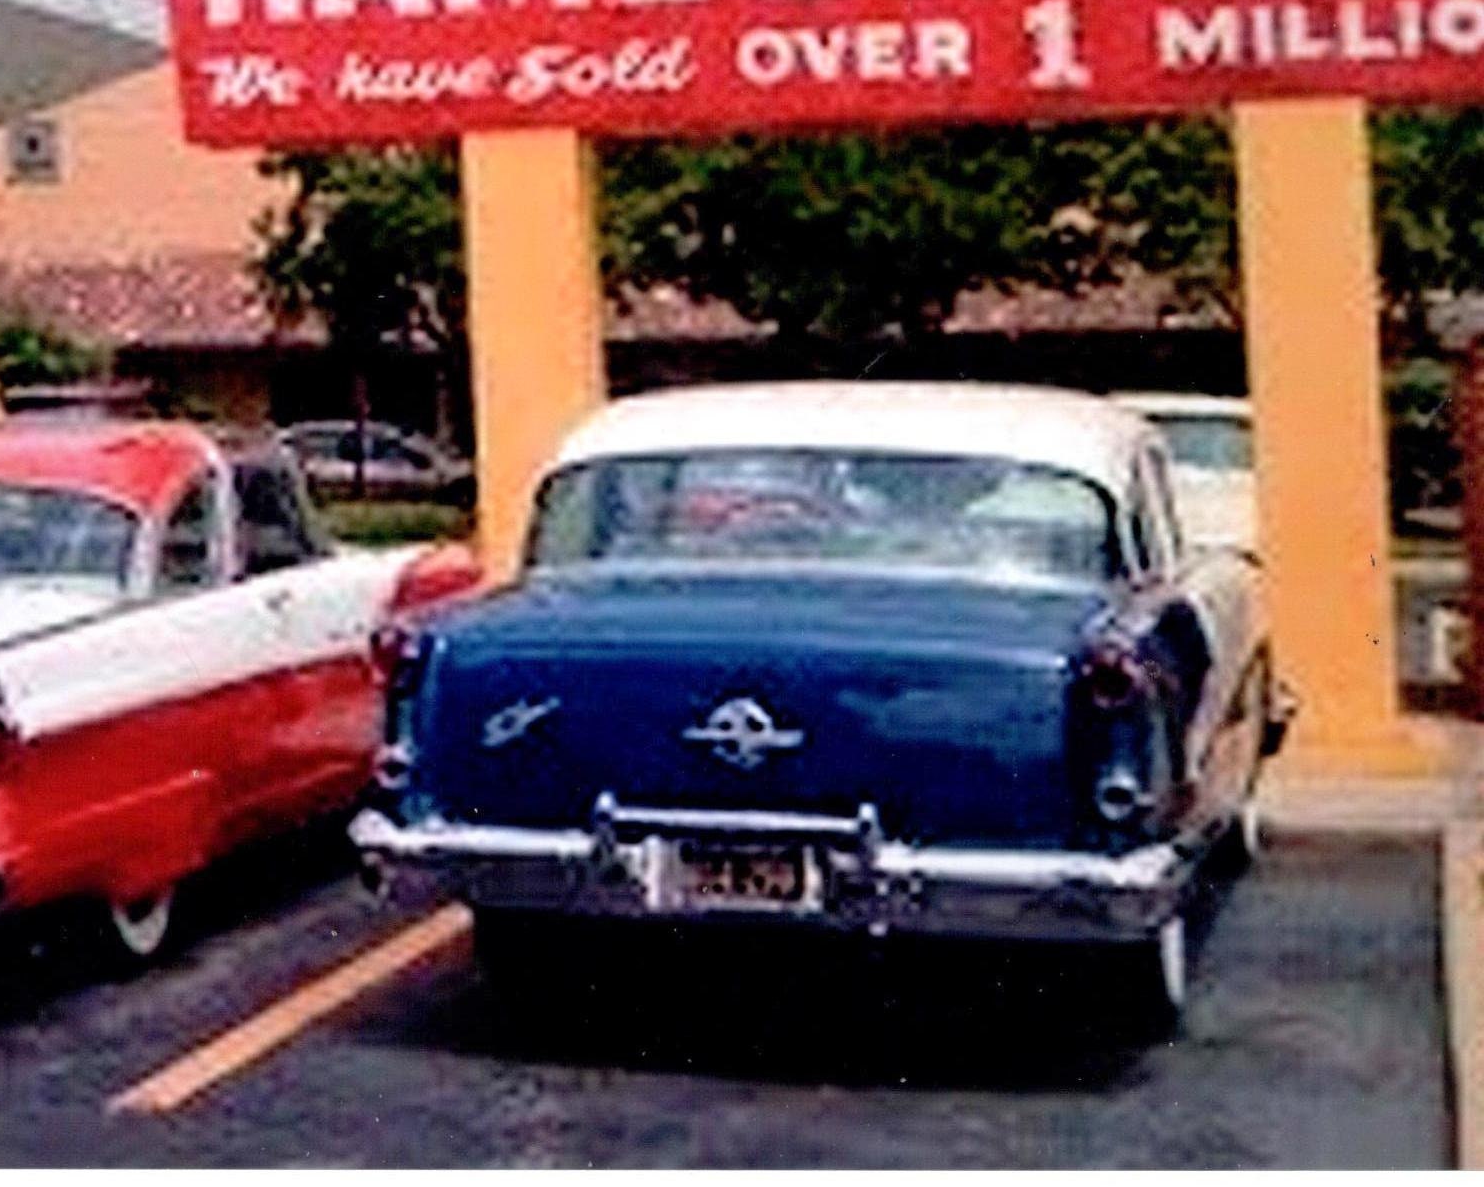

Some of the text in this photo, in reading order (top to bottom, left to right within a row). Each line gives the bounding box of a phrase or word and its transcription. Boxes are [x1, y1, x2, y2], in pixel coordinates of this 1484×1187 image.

[197, 53, 311, 108] We
[334, 52, 499, 102] have
[735, 19, 974, 87] OVER
